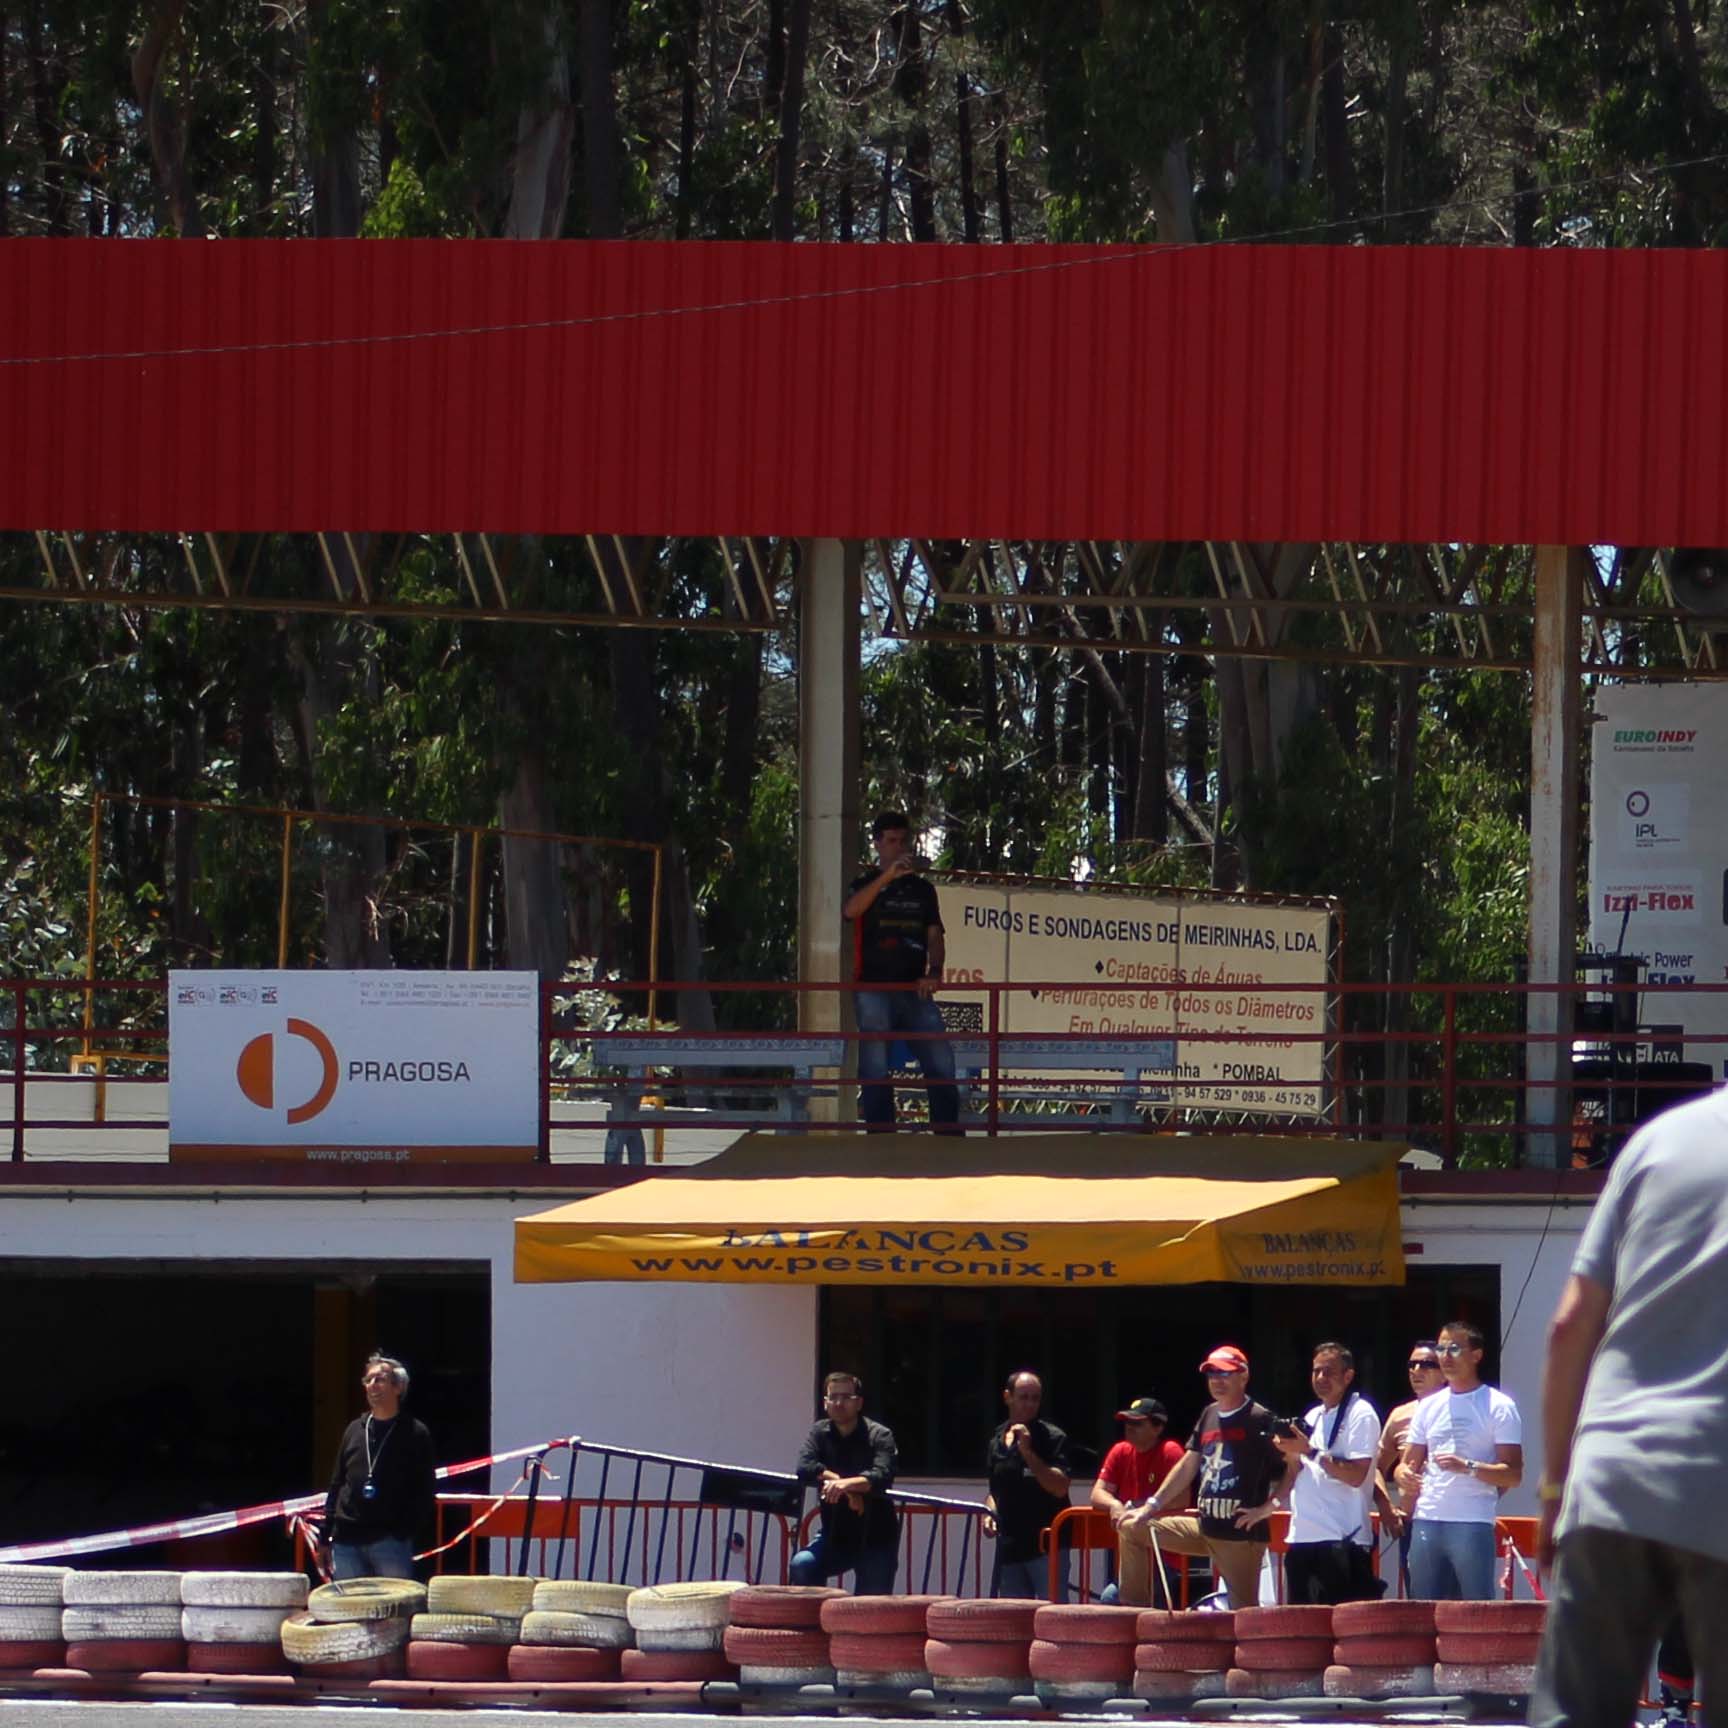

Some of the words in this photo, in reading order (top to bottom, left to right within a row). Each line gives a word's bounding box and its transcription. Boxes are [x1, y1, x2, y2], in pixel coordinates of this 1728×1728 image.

[1612, 729, 1699, 744] EUROINDY
[1635, 823, 1658, 838] IPL
[964, 905, 1023, 933] FUROS
[1029, 914, 1040, 936] E
[1045, 916, 1152, 943] SONDAGENS
[1157, 923, 1180, 944] DE
[1285, 931, 1322, 953] LDA.
[1654, 952, 1695, 969] Power
[1192, 965, 1210, 984] de
[1140, 993, 1159, 1011] de
[1164, 992, 1210, 1015] Todos
[1215, 999, 1233, 1015] os
[1069, 1015, 1094, 1033] Em
[349, 1061, 471, 1082] PRAGOSA
[1223, 1063, 1285, 1081] POMBAL
[306, 1149, 411, 1162] www.pragosa.pt
[631, 1254, 1118, 1282] www.pestronix.pt
